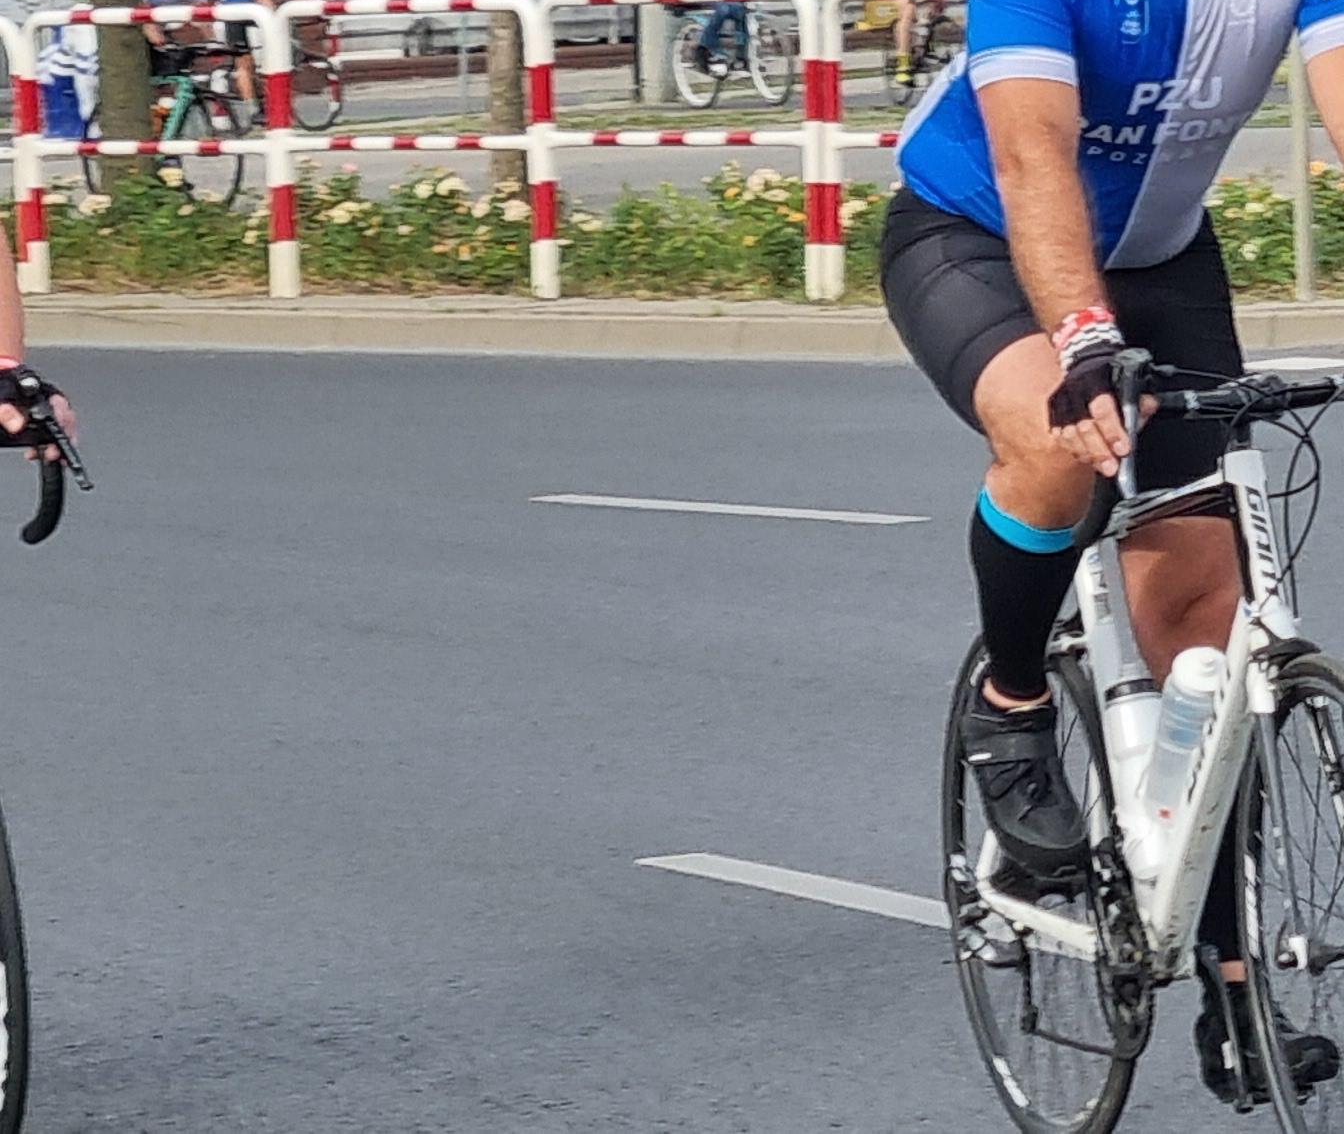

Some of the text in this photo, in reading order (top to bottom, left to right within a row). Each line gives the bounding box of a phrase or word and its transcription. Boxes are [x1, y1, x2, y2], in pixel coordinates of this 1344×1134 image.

[1127, 76, 1223, 116] PZU
[1078, 116, 1237, 145] AN FON
